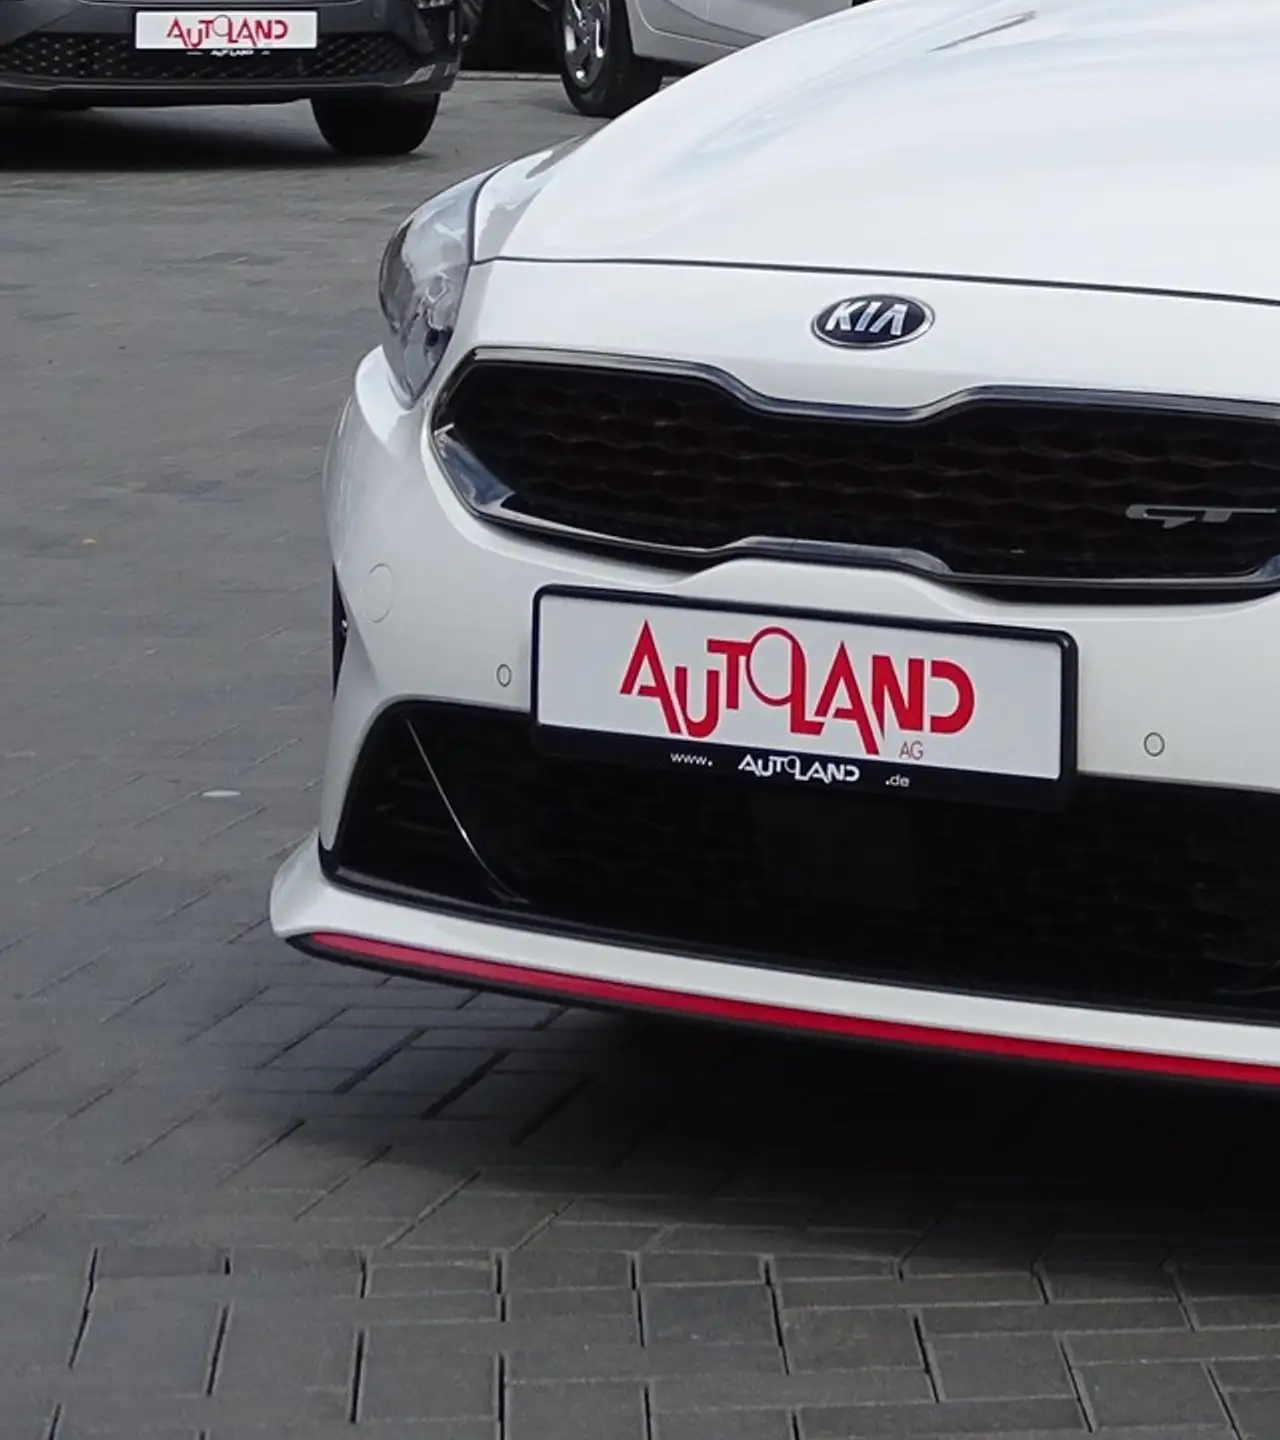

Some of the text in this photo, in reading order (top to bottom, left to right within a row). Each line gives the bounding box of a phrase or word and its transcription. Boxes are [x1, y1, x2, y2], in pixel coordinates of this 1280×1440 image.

[166, 14, 289, 48] AUTOLAND
[824, 300, 910, 336] KIA
[619, 619, 976, 756] AUTOLAND
[899, 739, 924, 761] AG
[670, 752, 713, 767] www.
[738, 754, 860, 785] AUTOLAND
